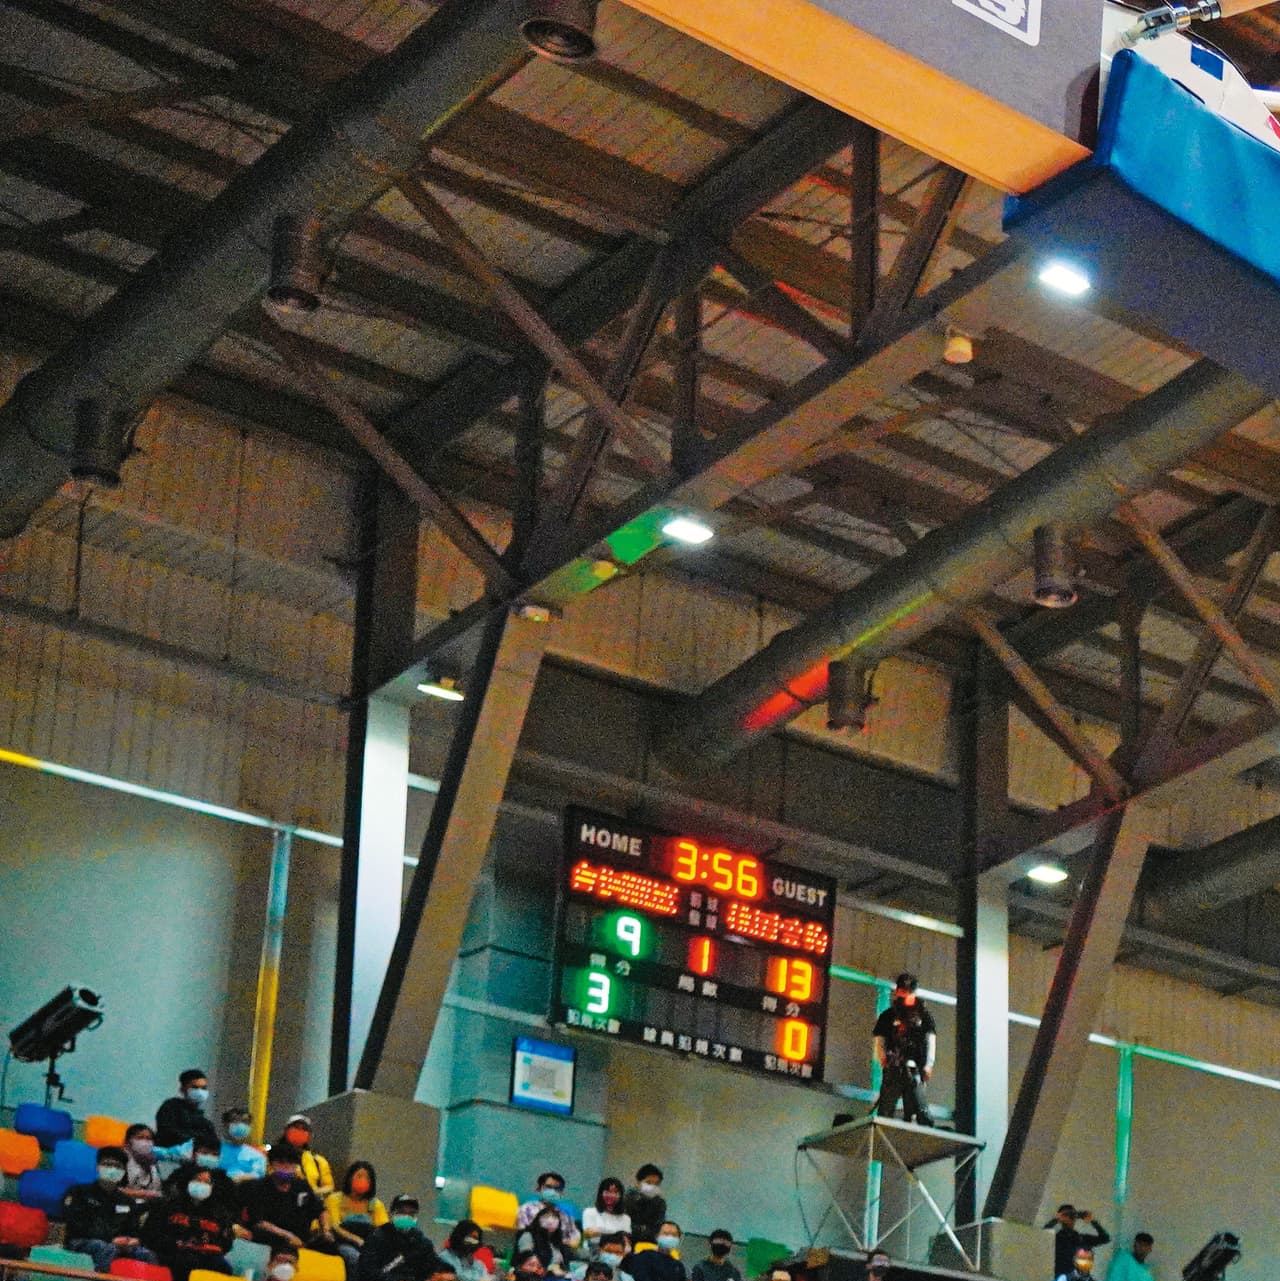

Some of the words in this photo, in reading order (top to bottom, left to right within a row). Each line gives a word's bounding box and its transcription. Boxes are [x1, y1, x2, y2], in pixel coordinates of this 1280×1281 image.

[580, 823, 643, 857] HOME
[675, 841, 759, 898] 3:56
[772, 877, 828, 907] GUEST
[616, 915, 642, 957] 9
[700, 938, 712, 974] 1
[585, 971, 611, 1015] 3
[776, 957, 813, 1001] 13
[782, 1019, 809, 1062] 0
